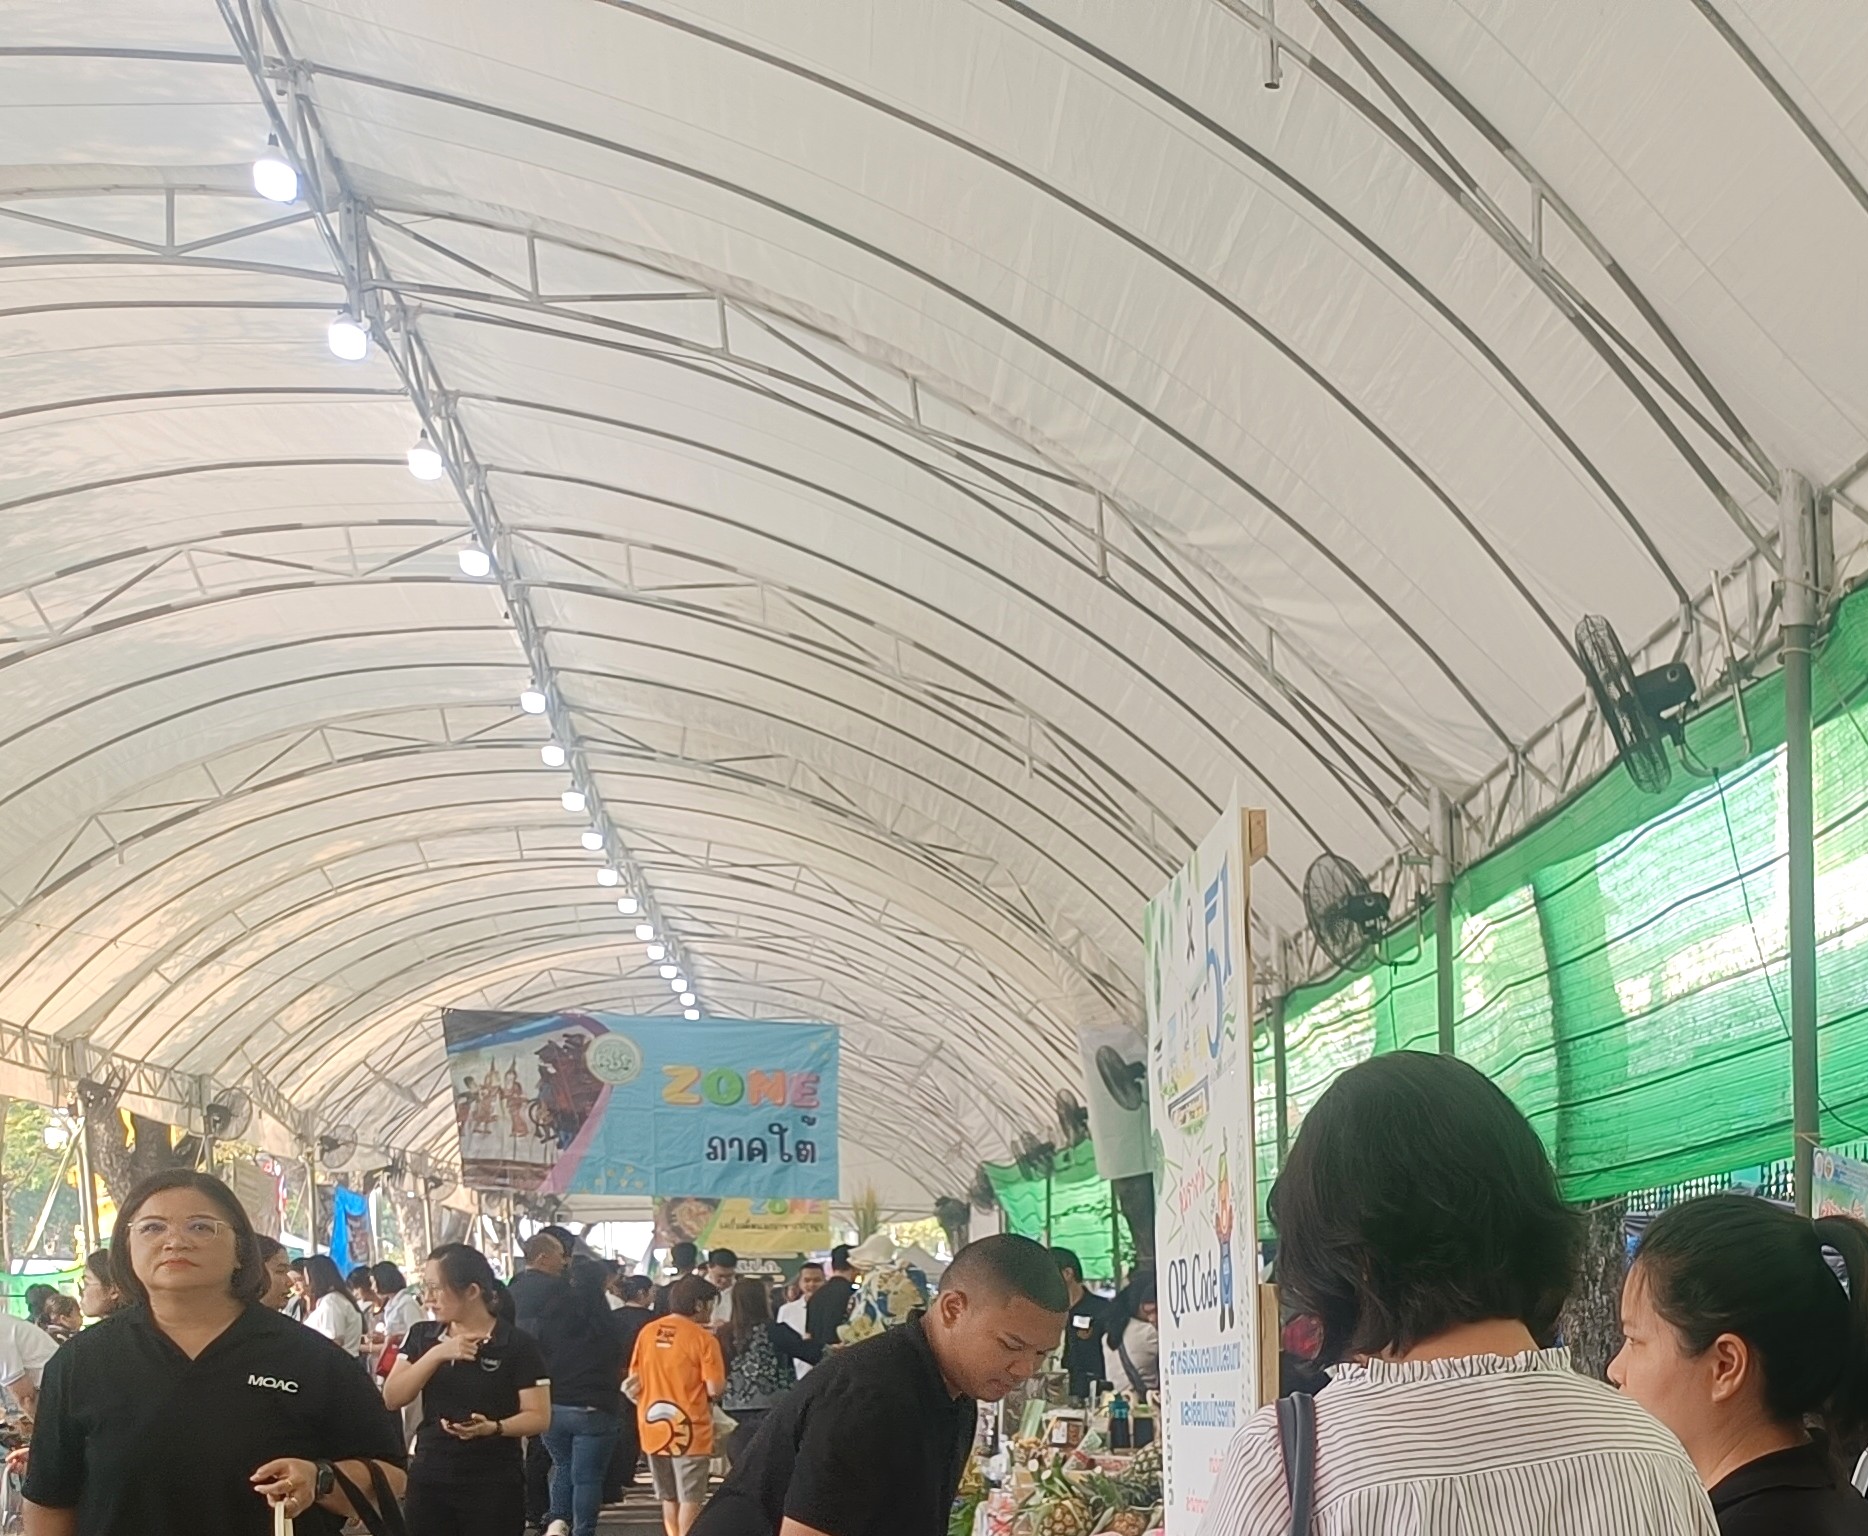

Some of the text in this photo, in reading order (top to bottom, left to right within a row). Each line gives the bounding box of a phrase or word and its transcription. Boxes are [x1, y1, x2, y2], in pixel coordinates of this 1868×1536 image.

[662, 1065, 820, 1109] ZONE
[705, 1115, 816, 1165] ภาคใต้
[1168, 1250, 1218, 1329] QR Code
